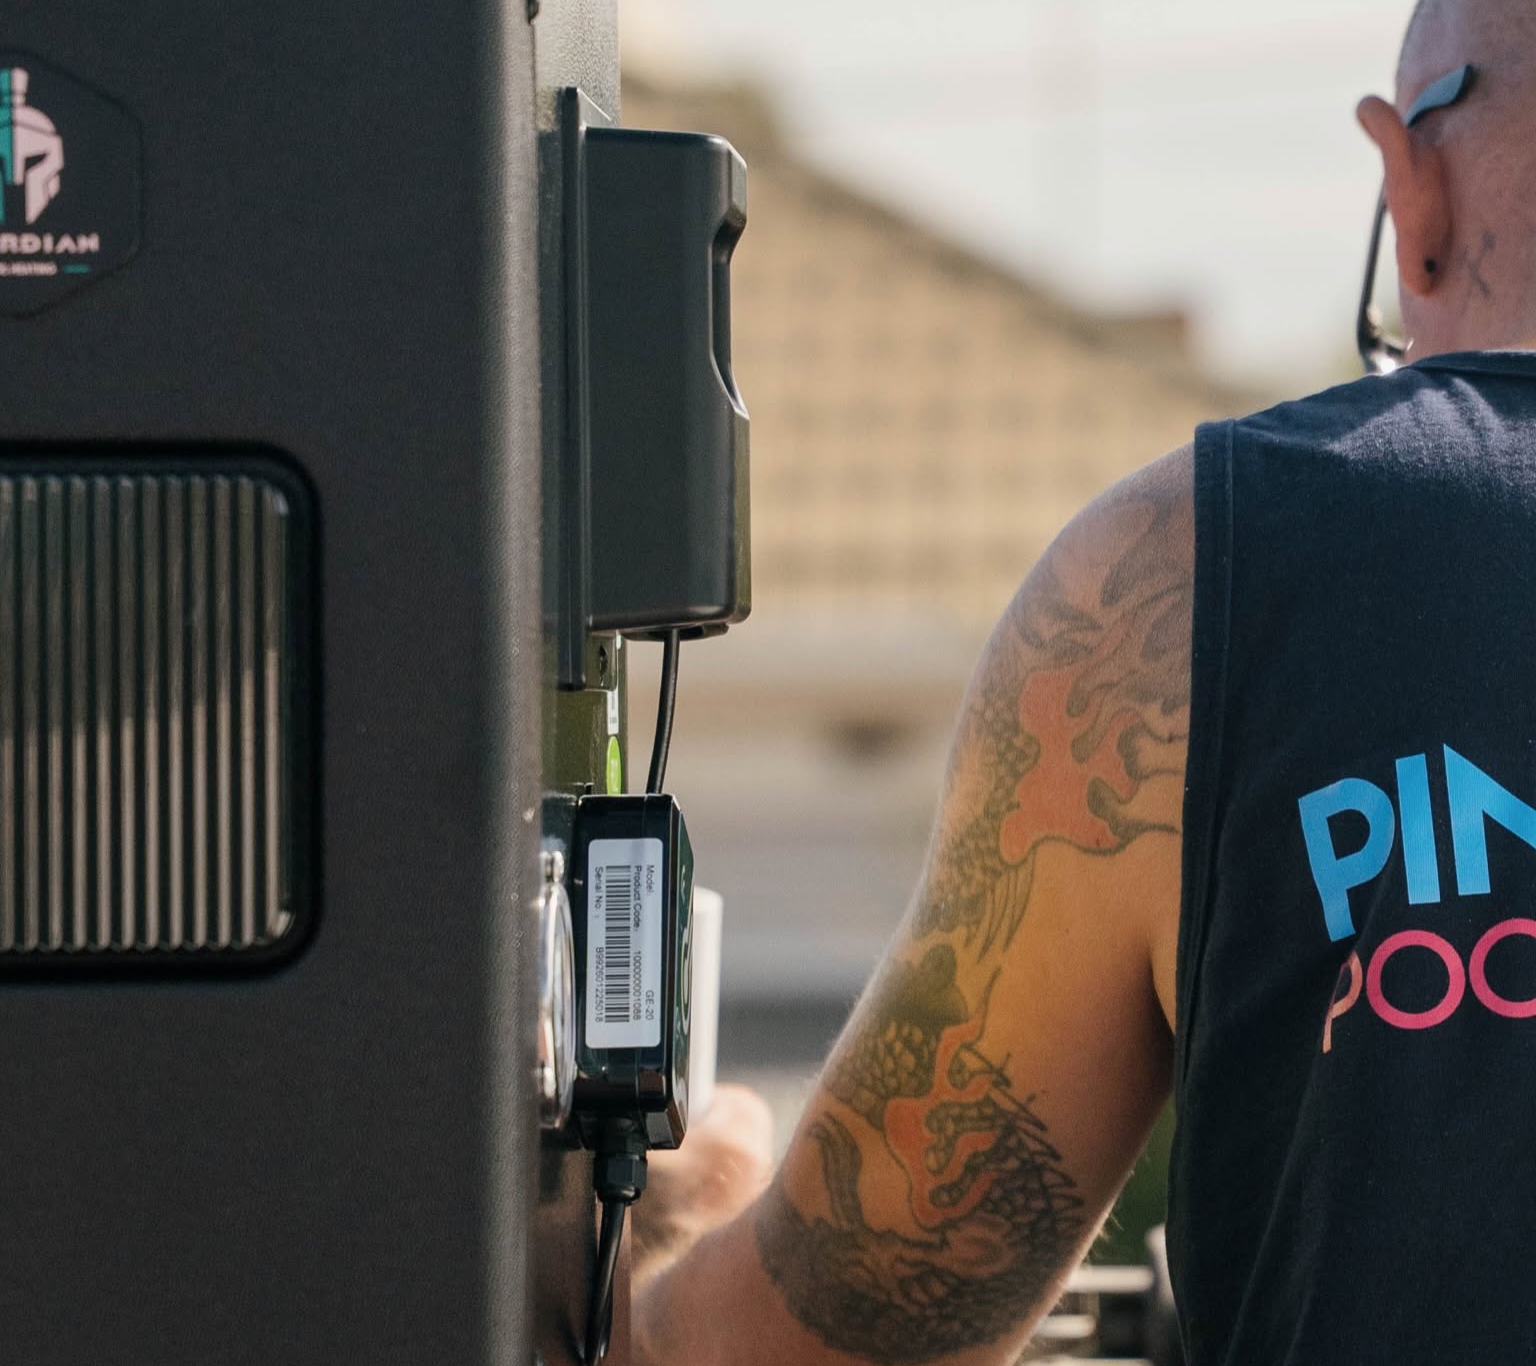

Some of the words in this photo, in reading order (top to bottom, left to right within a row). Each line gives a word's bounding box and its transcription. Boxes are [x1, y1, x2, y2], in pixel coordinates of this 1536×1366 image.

[595, 866, 604, 893] Serial
[633, 865, 642, 901] Product
[633, 903, 642, 932] Code:
[645, 990, 655, 1021] GE-20
